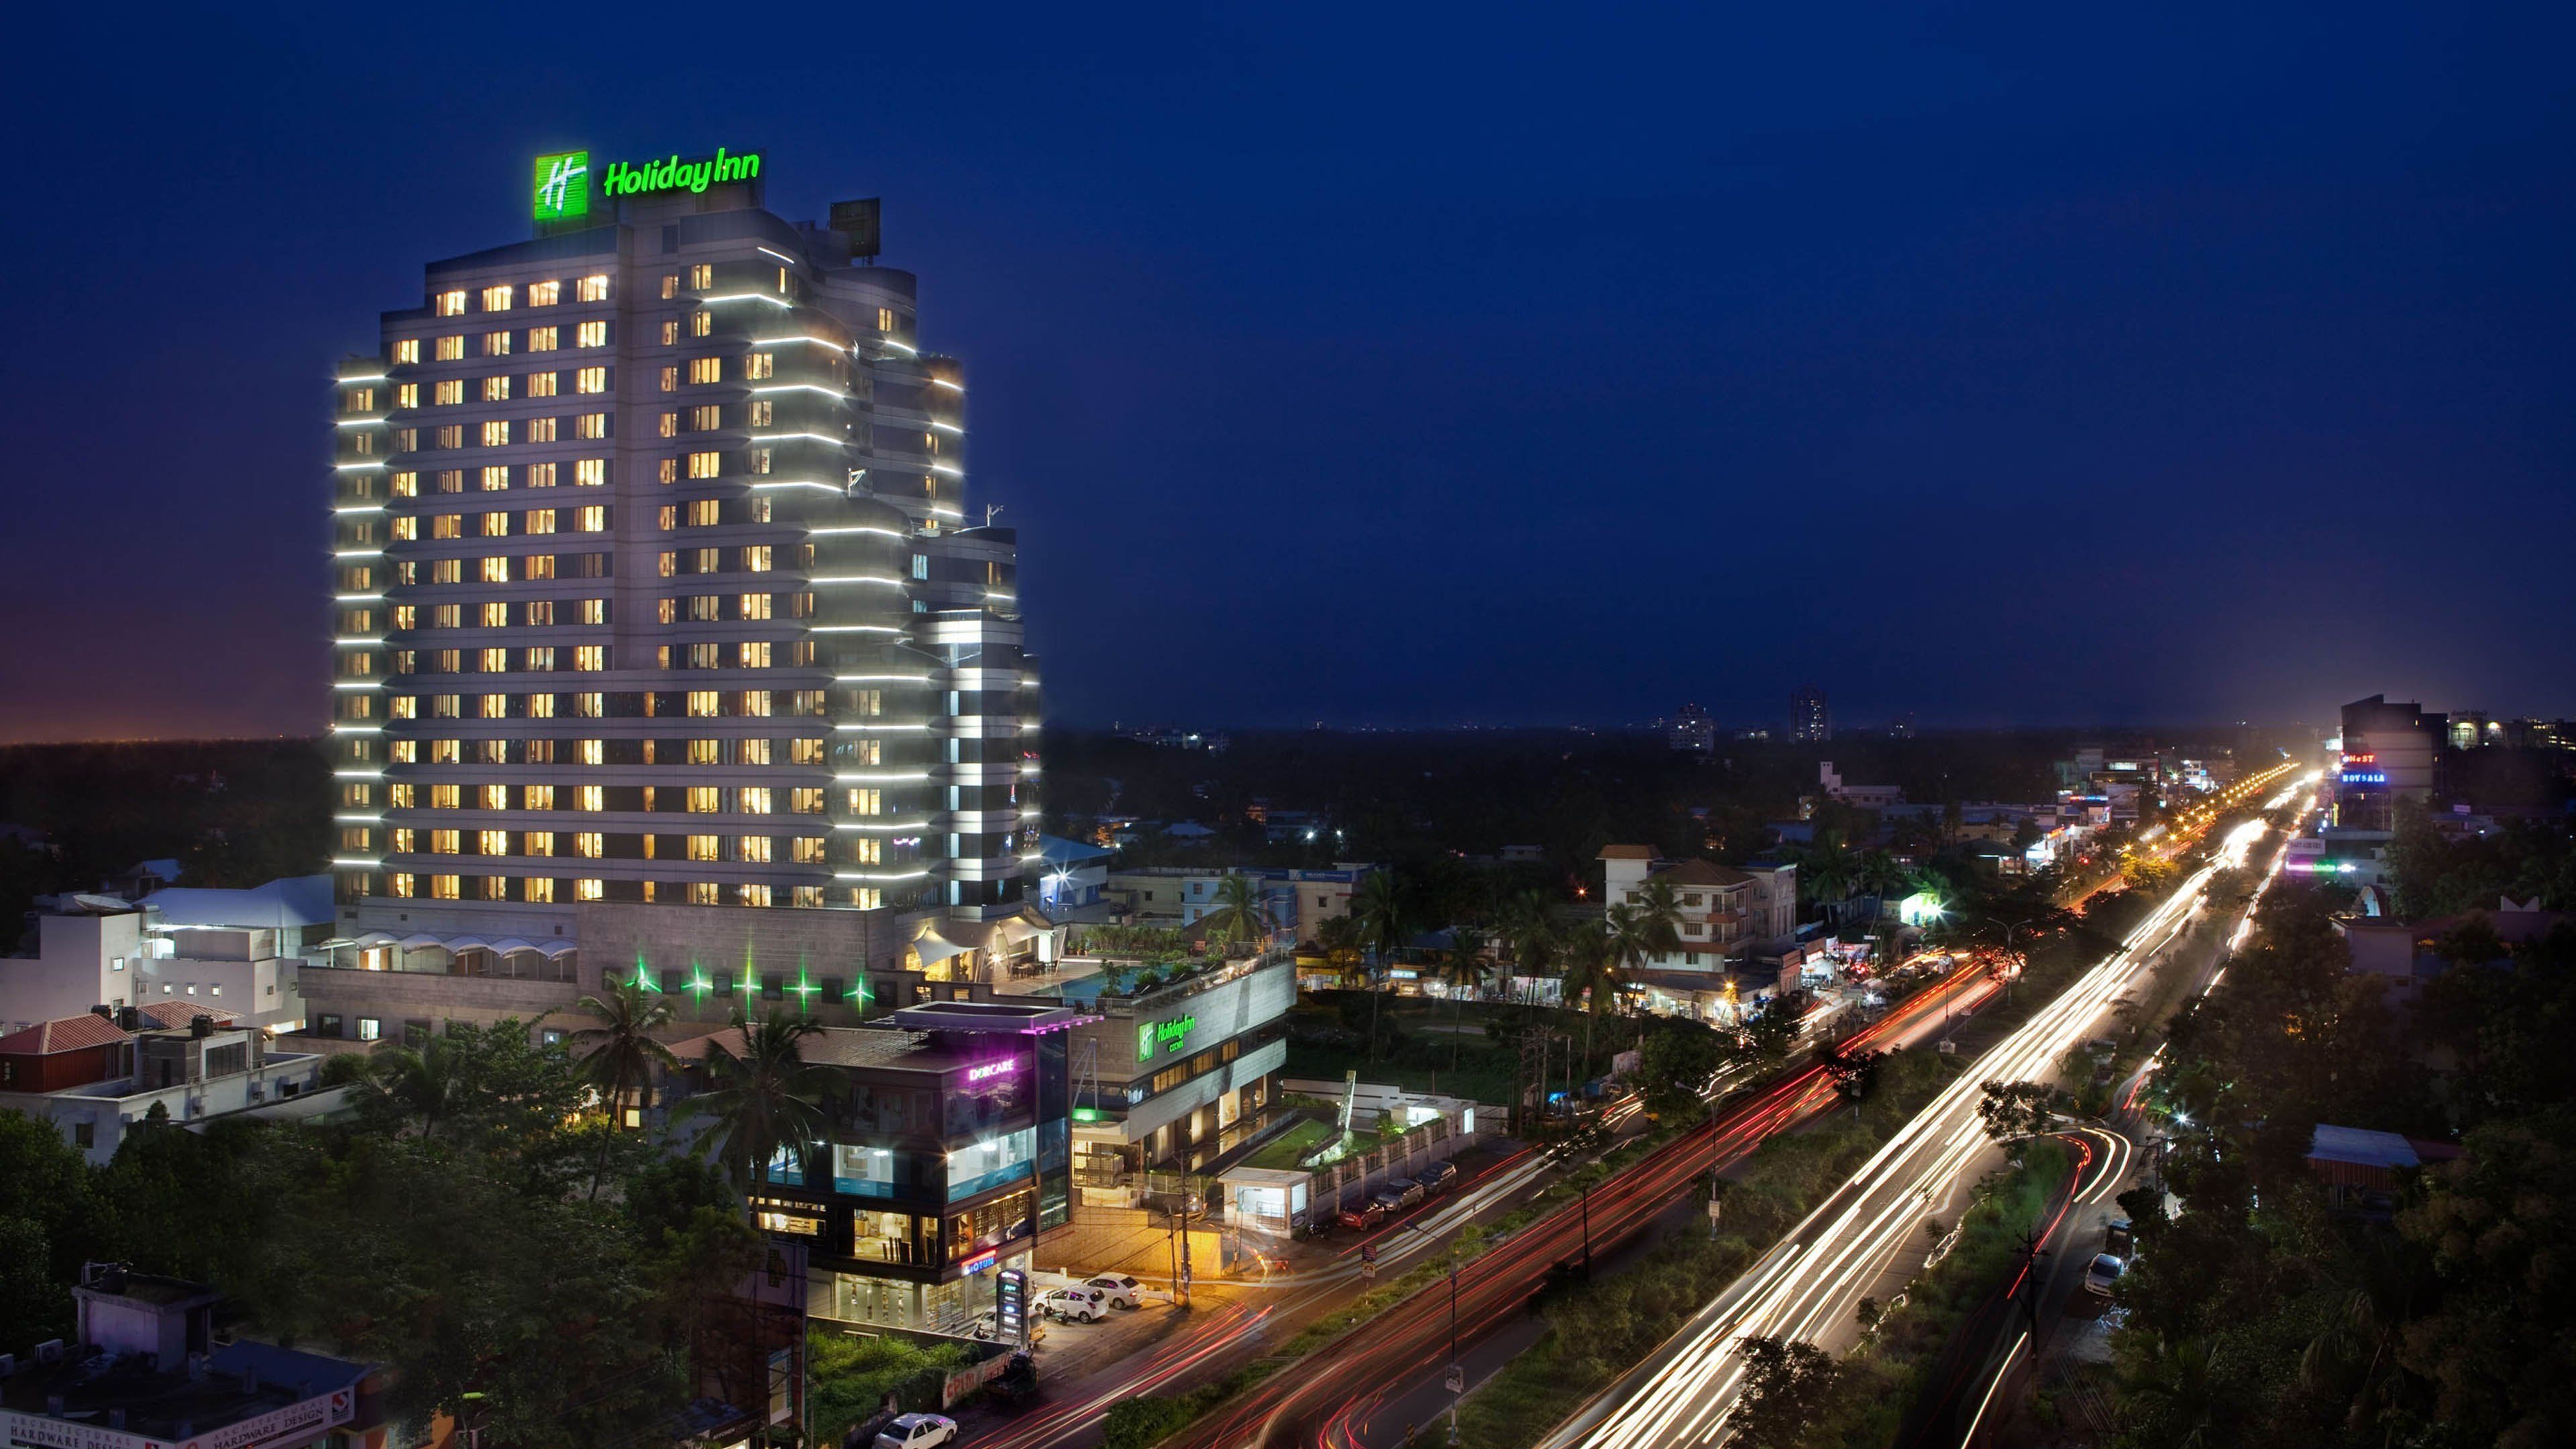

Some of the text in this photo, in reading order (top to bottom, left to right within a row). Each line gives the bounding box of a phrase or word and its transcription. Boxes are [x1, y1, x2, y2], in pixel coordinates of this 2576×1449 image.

[604, 148, 759, 197] Holiday Inn
[1157, 1014, 1195, 1043] Holiday Inn
[969, 1059, 1014, 1081] DORCARE
[10, 1426, 79, 1448] HARDWARE
[213, 1423, 276, 1449] HARDWARE
[284, 1408, 323, 1428] DESIGN
